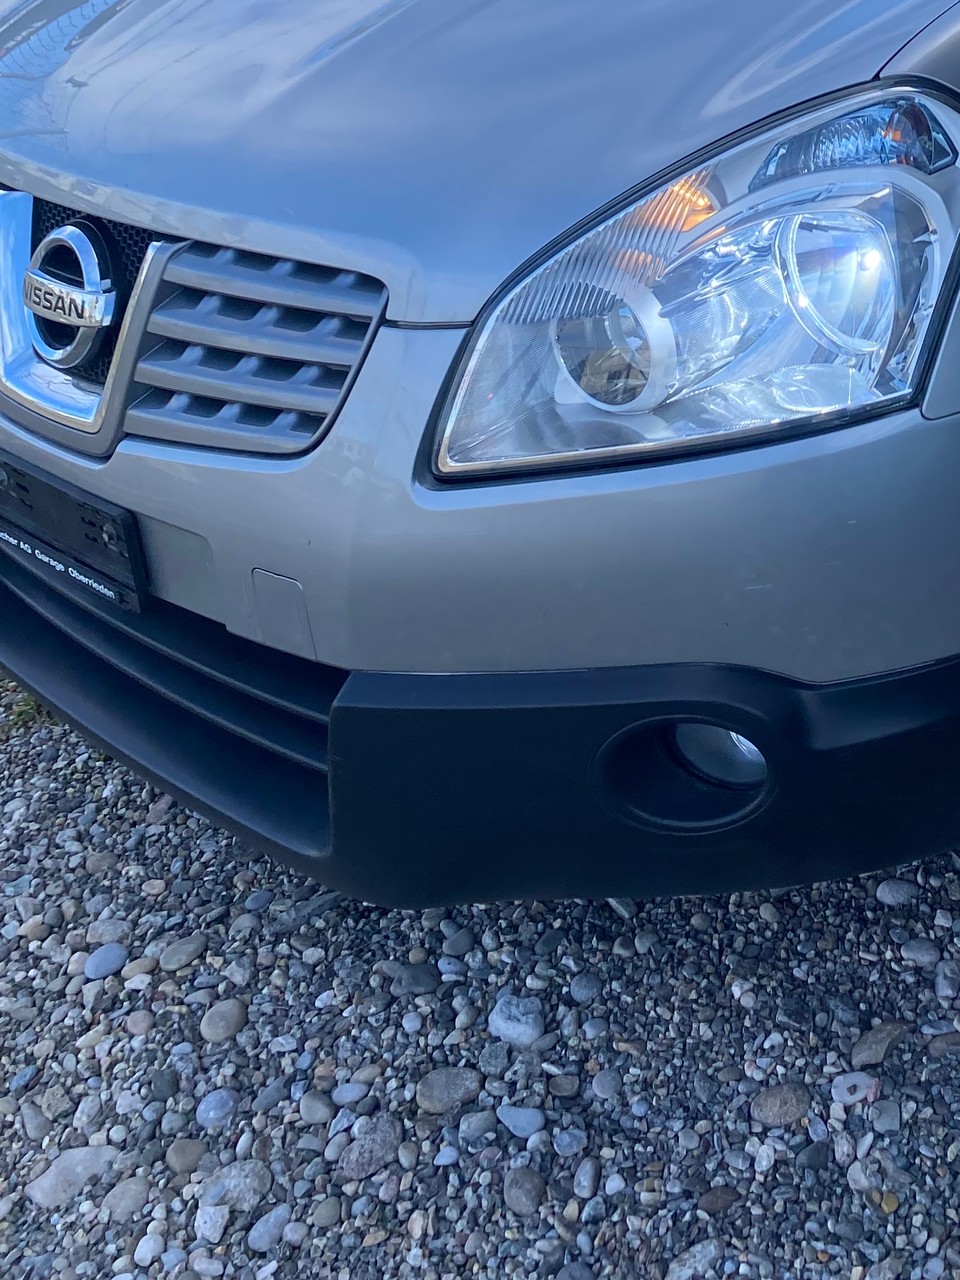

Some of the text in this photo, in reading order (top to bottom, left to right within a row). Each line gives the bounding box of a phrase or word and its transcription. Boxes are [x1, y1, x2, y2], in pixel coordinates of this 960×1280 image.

[23, 278, 85, 319] NISSAN
[34, 549, 65, 572] Garage
[68, 567, 115, 599] Oberrieden
